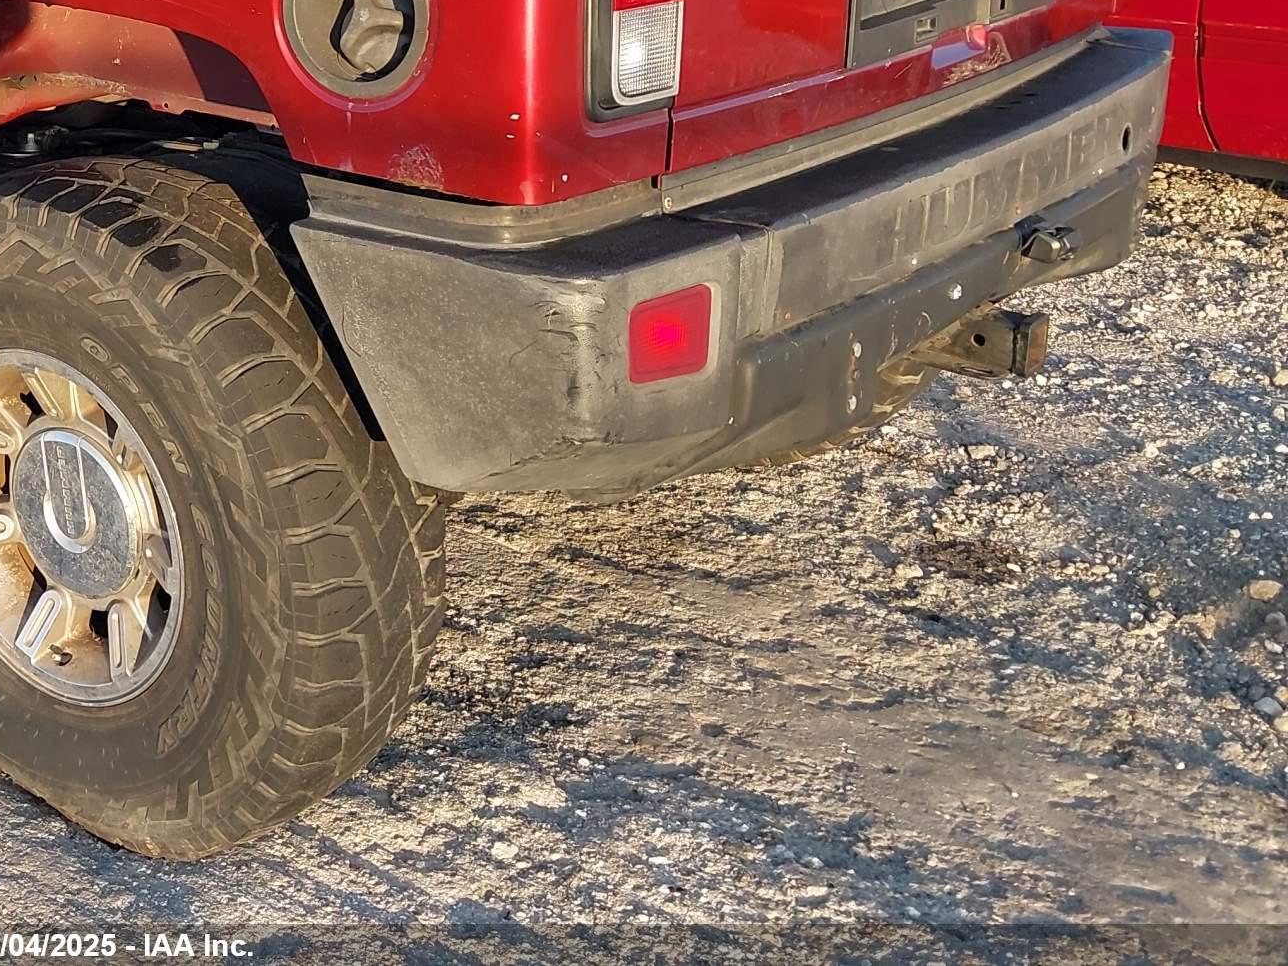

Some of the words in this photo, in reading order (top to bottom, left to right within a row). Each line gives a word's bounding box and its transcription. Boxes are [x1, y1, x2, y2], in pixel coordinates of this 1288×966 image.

[890, 115, 1114, 266] HUMMER
[56, 444, 76, 534] HUMMER
[80, 336, 192, 477] OPEN
[155, 502, 225, 758] COUNTRY
